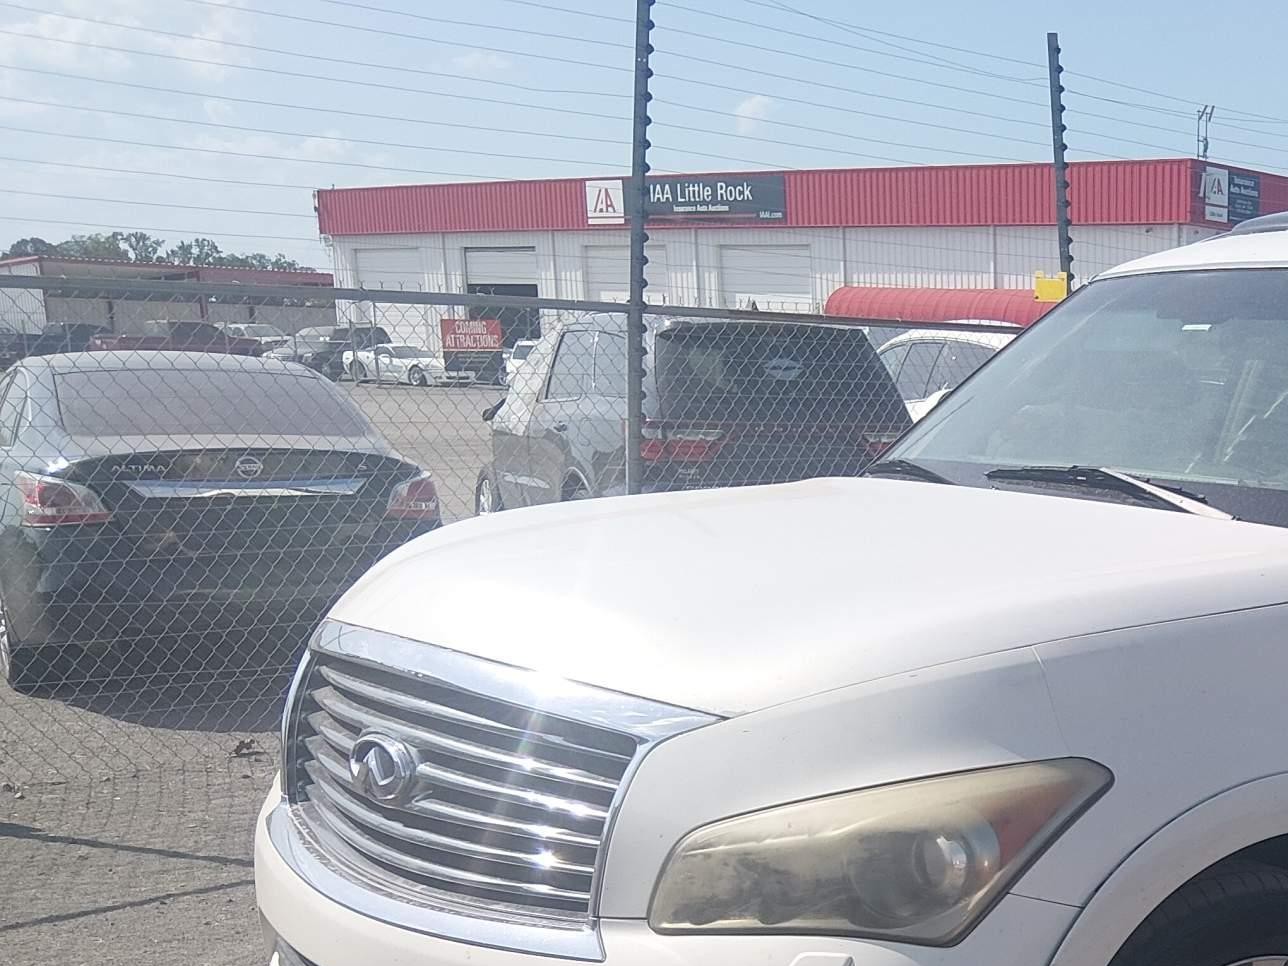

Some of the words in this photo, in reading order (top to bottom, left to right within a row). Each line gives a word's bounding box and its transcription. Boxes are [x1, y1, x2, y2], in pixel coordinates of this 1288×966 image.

[649, 183, 673, 203] IAA
[677, 183, 712, 202] Little
[717, 181, 752, 201] Rock
[455, 321, 487, 334] COMING
[445, 334, 499, 348] ATTRACTIONS
